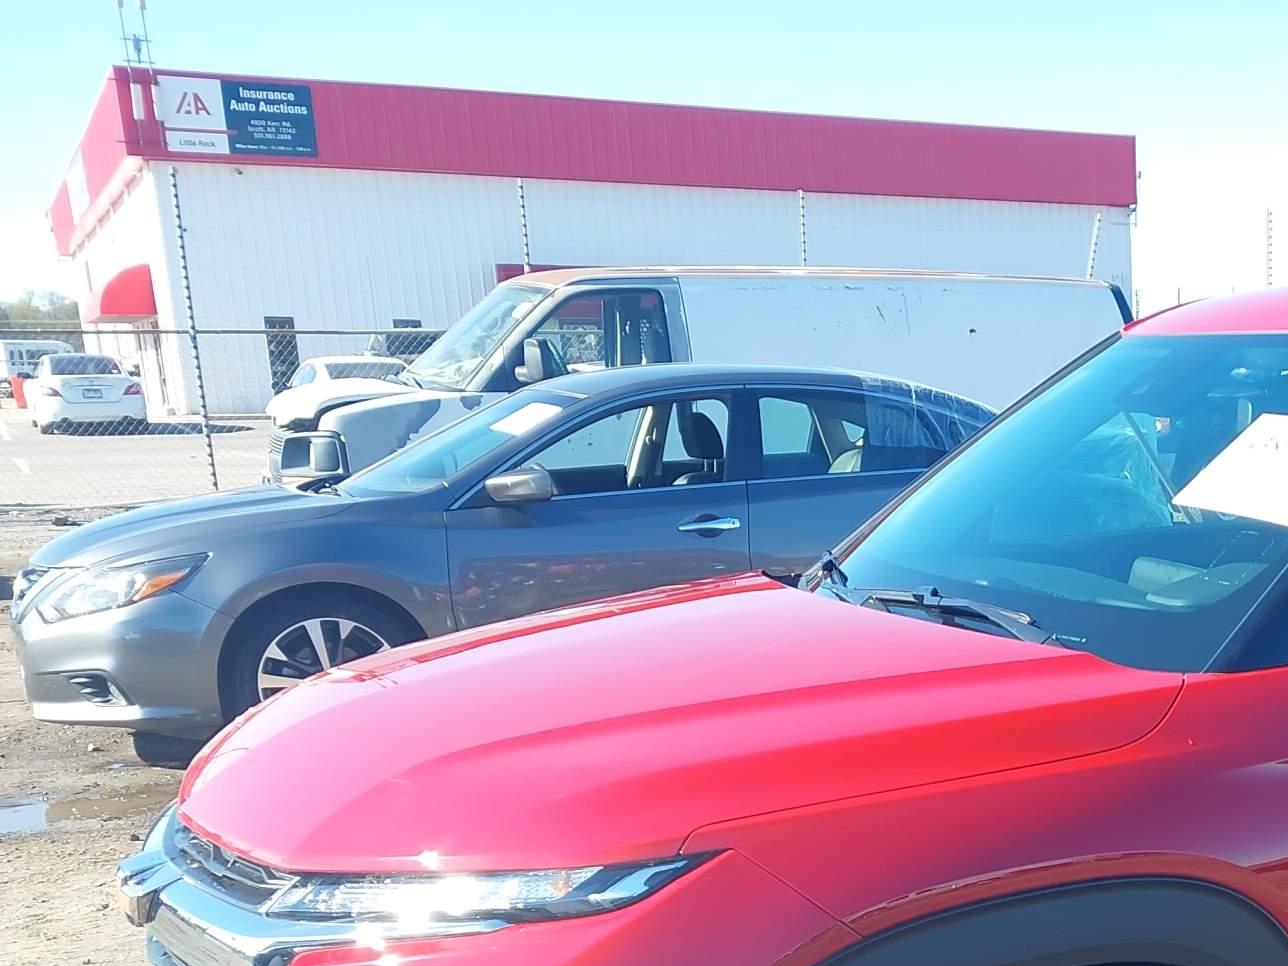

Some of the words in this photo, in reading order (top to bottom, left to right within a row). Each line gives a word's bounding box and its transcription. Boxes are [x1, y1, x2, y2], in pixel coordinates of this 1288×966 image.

[238, 86, 295, 101] Insurance
[229, 99, 256, 112] Auto
[258, 101, 308, 115] Auctions
[179, 138, 197, 147] Little
[198, 139, 216, 148] Rock
